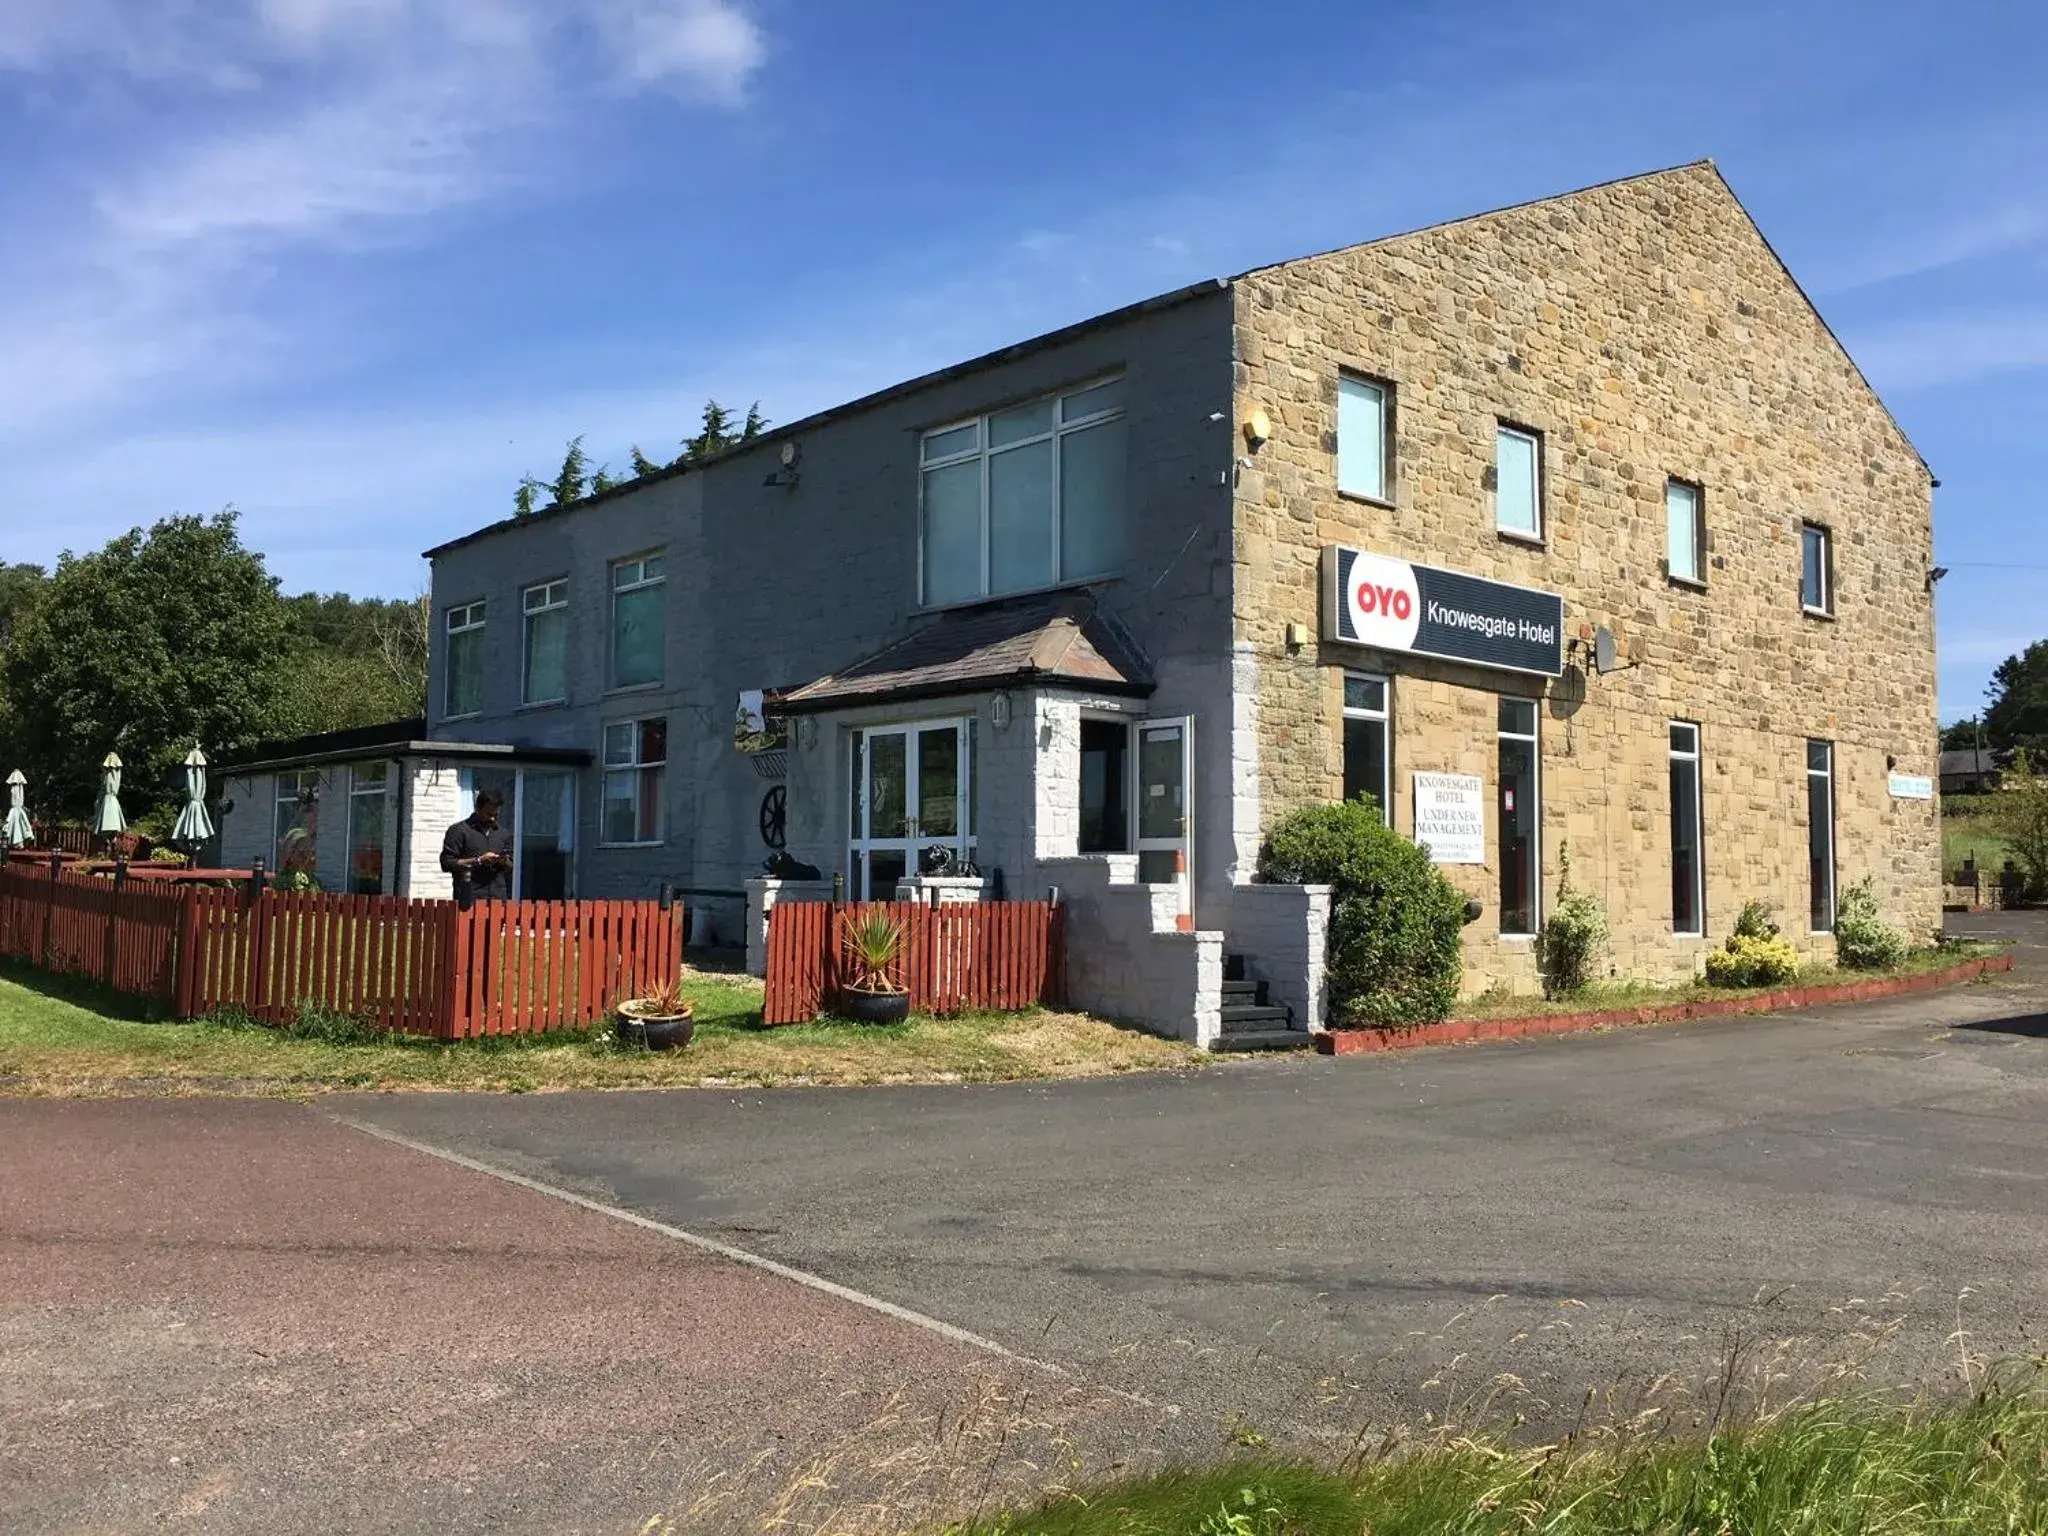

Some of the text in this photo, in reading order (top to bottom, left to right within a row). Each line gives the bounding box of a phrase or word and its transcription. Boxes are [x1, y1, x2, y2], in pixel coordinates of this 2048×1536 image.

[1358, 582, 1411, 620] OYO
[1428, 600, 1554, 645] Knowesgate Hotel
[1419, 776, 1479, 791] KNOWESGATE
[1435, 790, 1465, 803] HOTEL
[1423, 808, 1478, 821] UNDER NEW
[1418, 822, 1482, 835] MANAGEMENT
